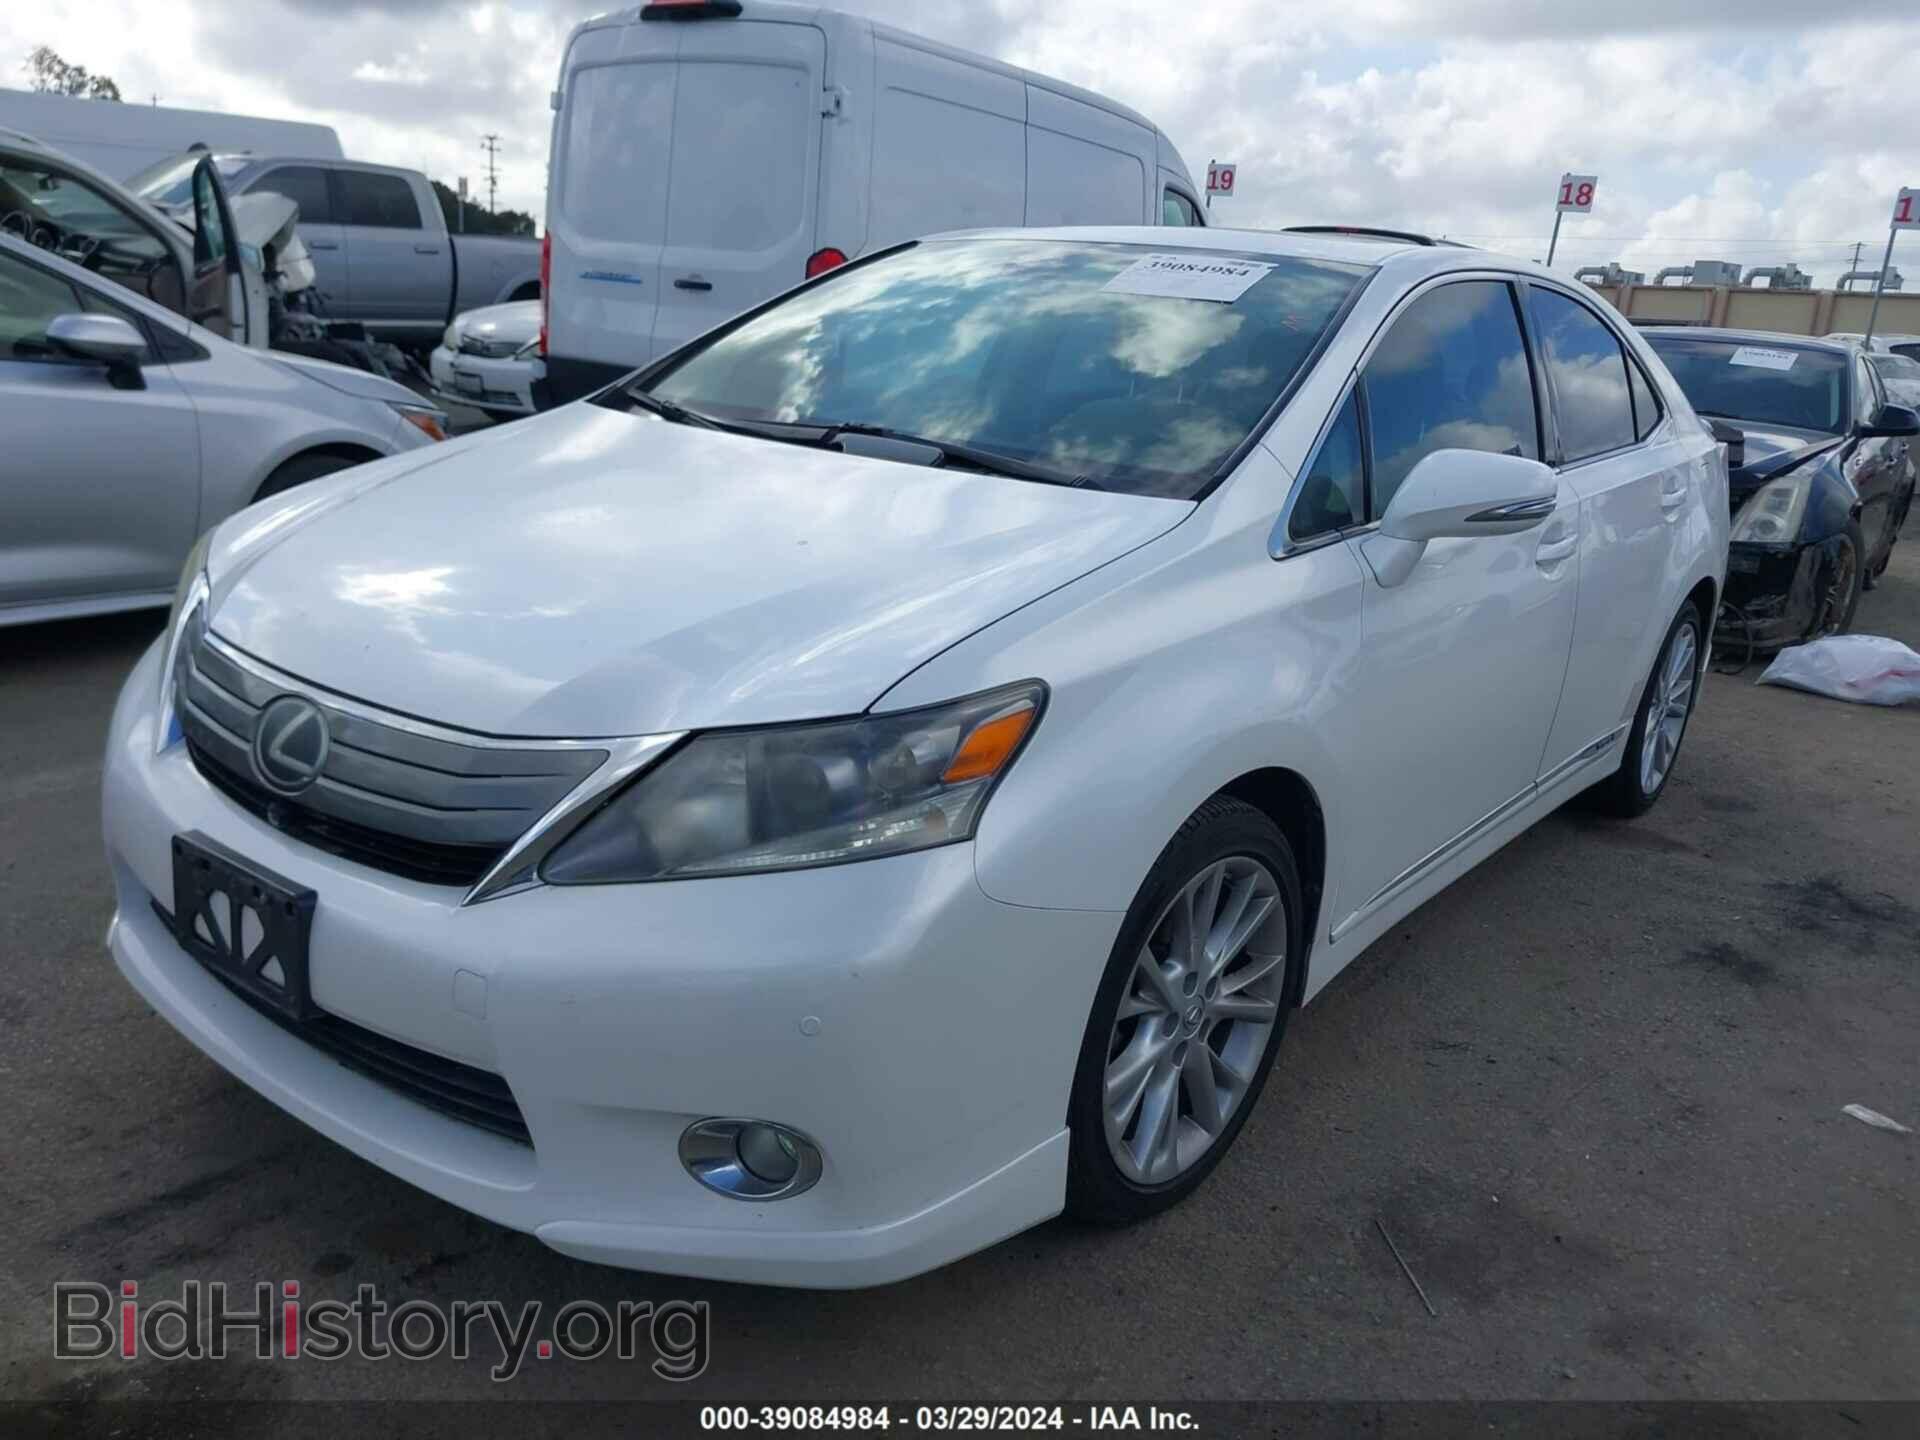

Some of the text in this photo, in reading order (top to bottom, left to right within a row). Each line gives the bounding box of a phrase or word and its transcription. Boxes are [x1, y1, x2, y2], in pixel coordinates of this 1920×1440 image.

[1207, 170, 1233, 190] 19
[1558, 182, 1593, 206] 18
[1894, 196, 1920, 224] 1
